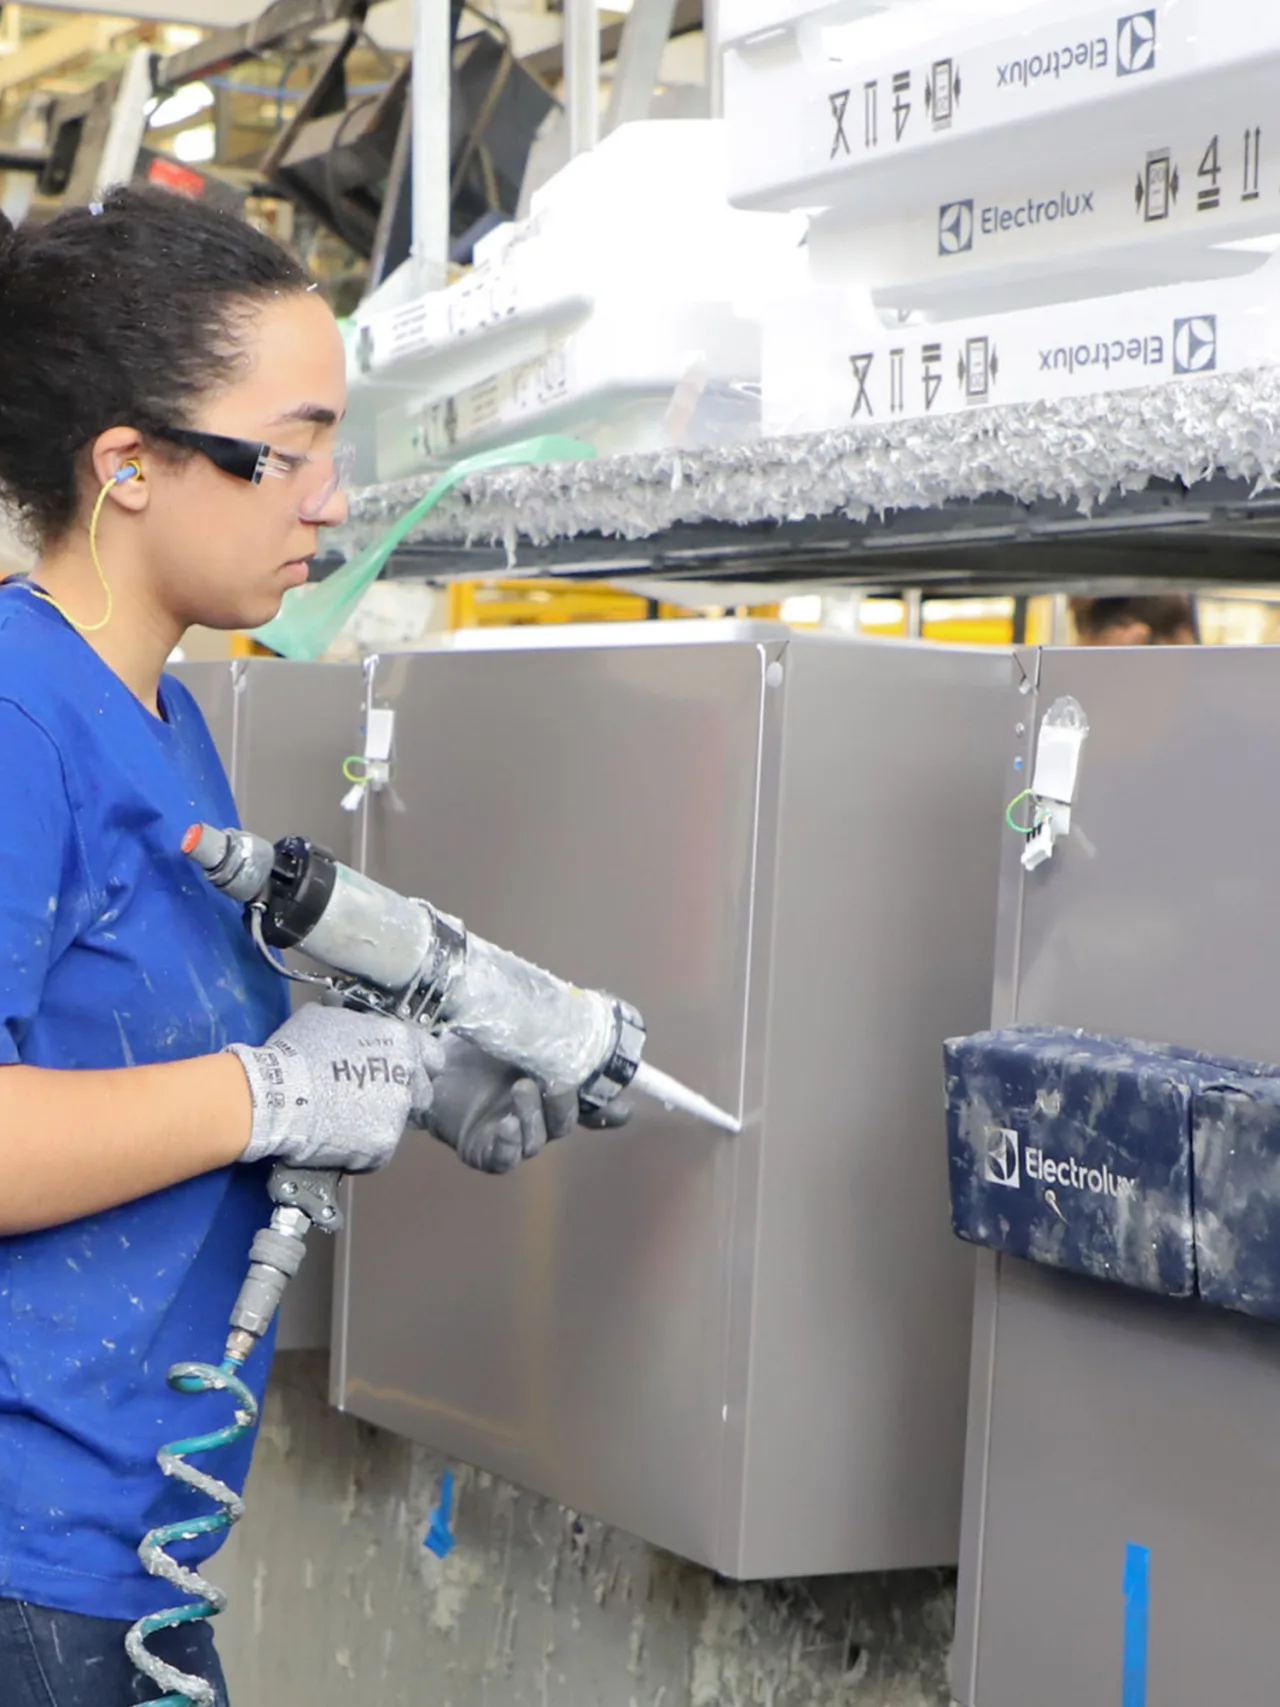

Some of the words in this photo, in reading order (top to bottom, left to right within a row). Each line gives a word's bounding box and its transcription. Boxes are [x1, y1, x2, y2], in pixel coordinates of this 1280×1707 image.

[996, 37, 1108, 89] Electrolux
[981, 189, 1094, 236] Electrolux
[1038, 335, 1163, 373] Electrolux
[1025, 1147, 1137, 1201] Electrolux
